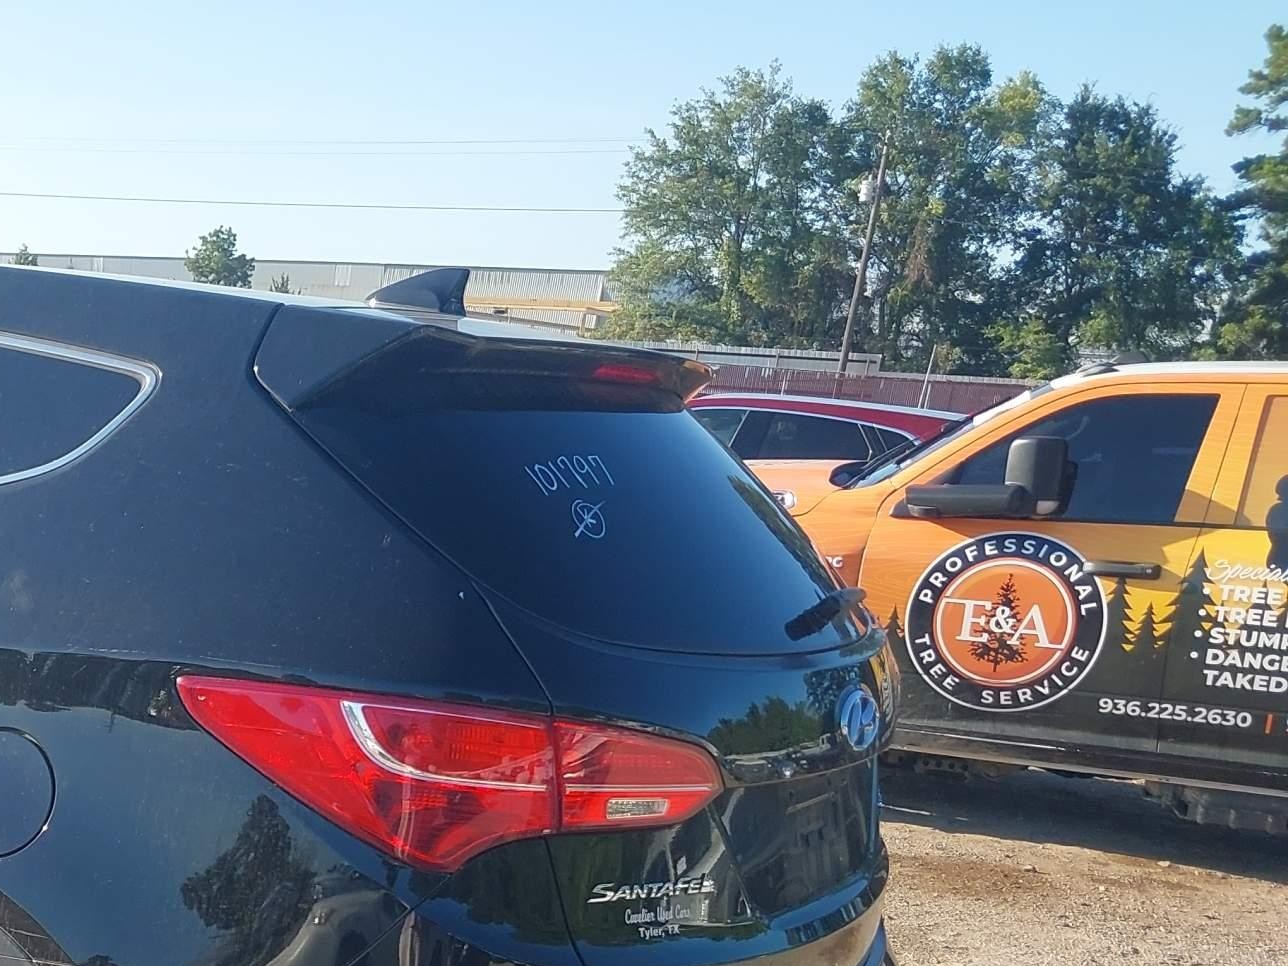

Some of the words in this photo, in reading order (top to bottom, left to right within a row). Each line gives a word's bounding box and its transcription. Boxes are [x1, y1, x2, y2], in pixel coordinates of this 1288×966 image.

[918, 538, 1097, 616] PROFESSIONAL
[1219, 583, 1283, 606] TREE
[943, 595, 1066, 650] E&A
[1215, 605, 1278, 628] TREE
[915, 632, 960, 691] TREE
[980, 646, 1090, 705] SERVICE
[1098, 698, 1253, 728] 936.225.2630
[638, 926, 665, 940] Tyler,
[666, 924, 681, 935] TX
